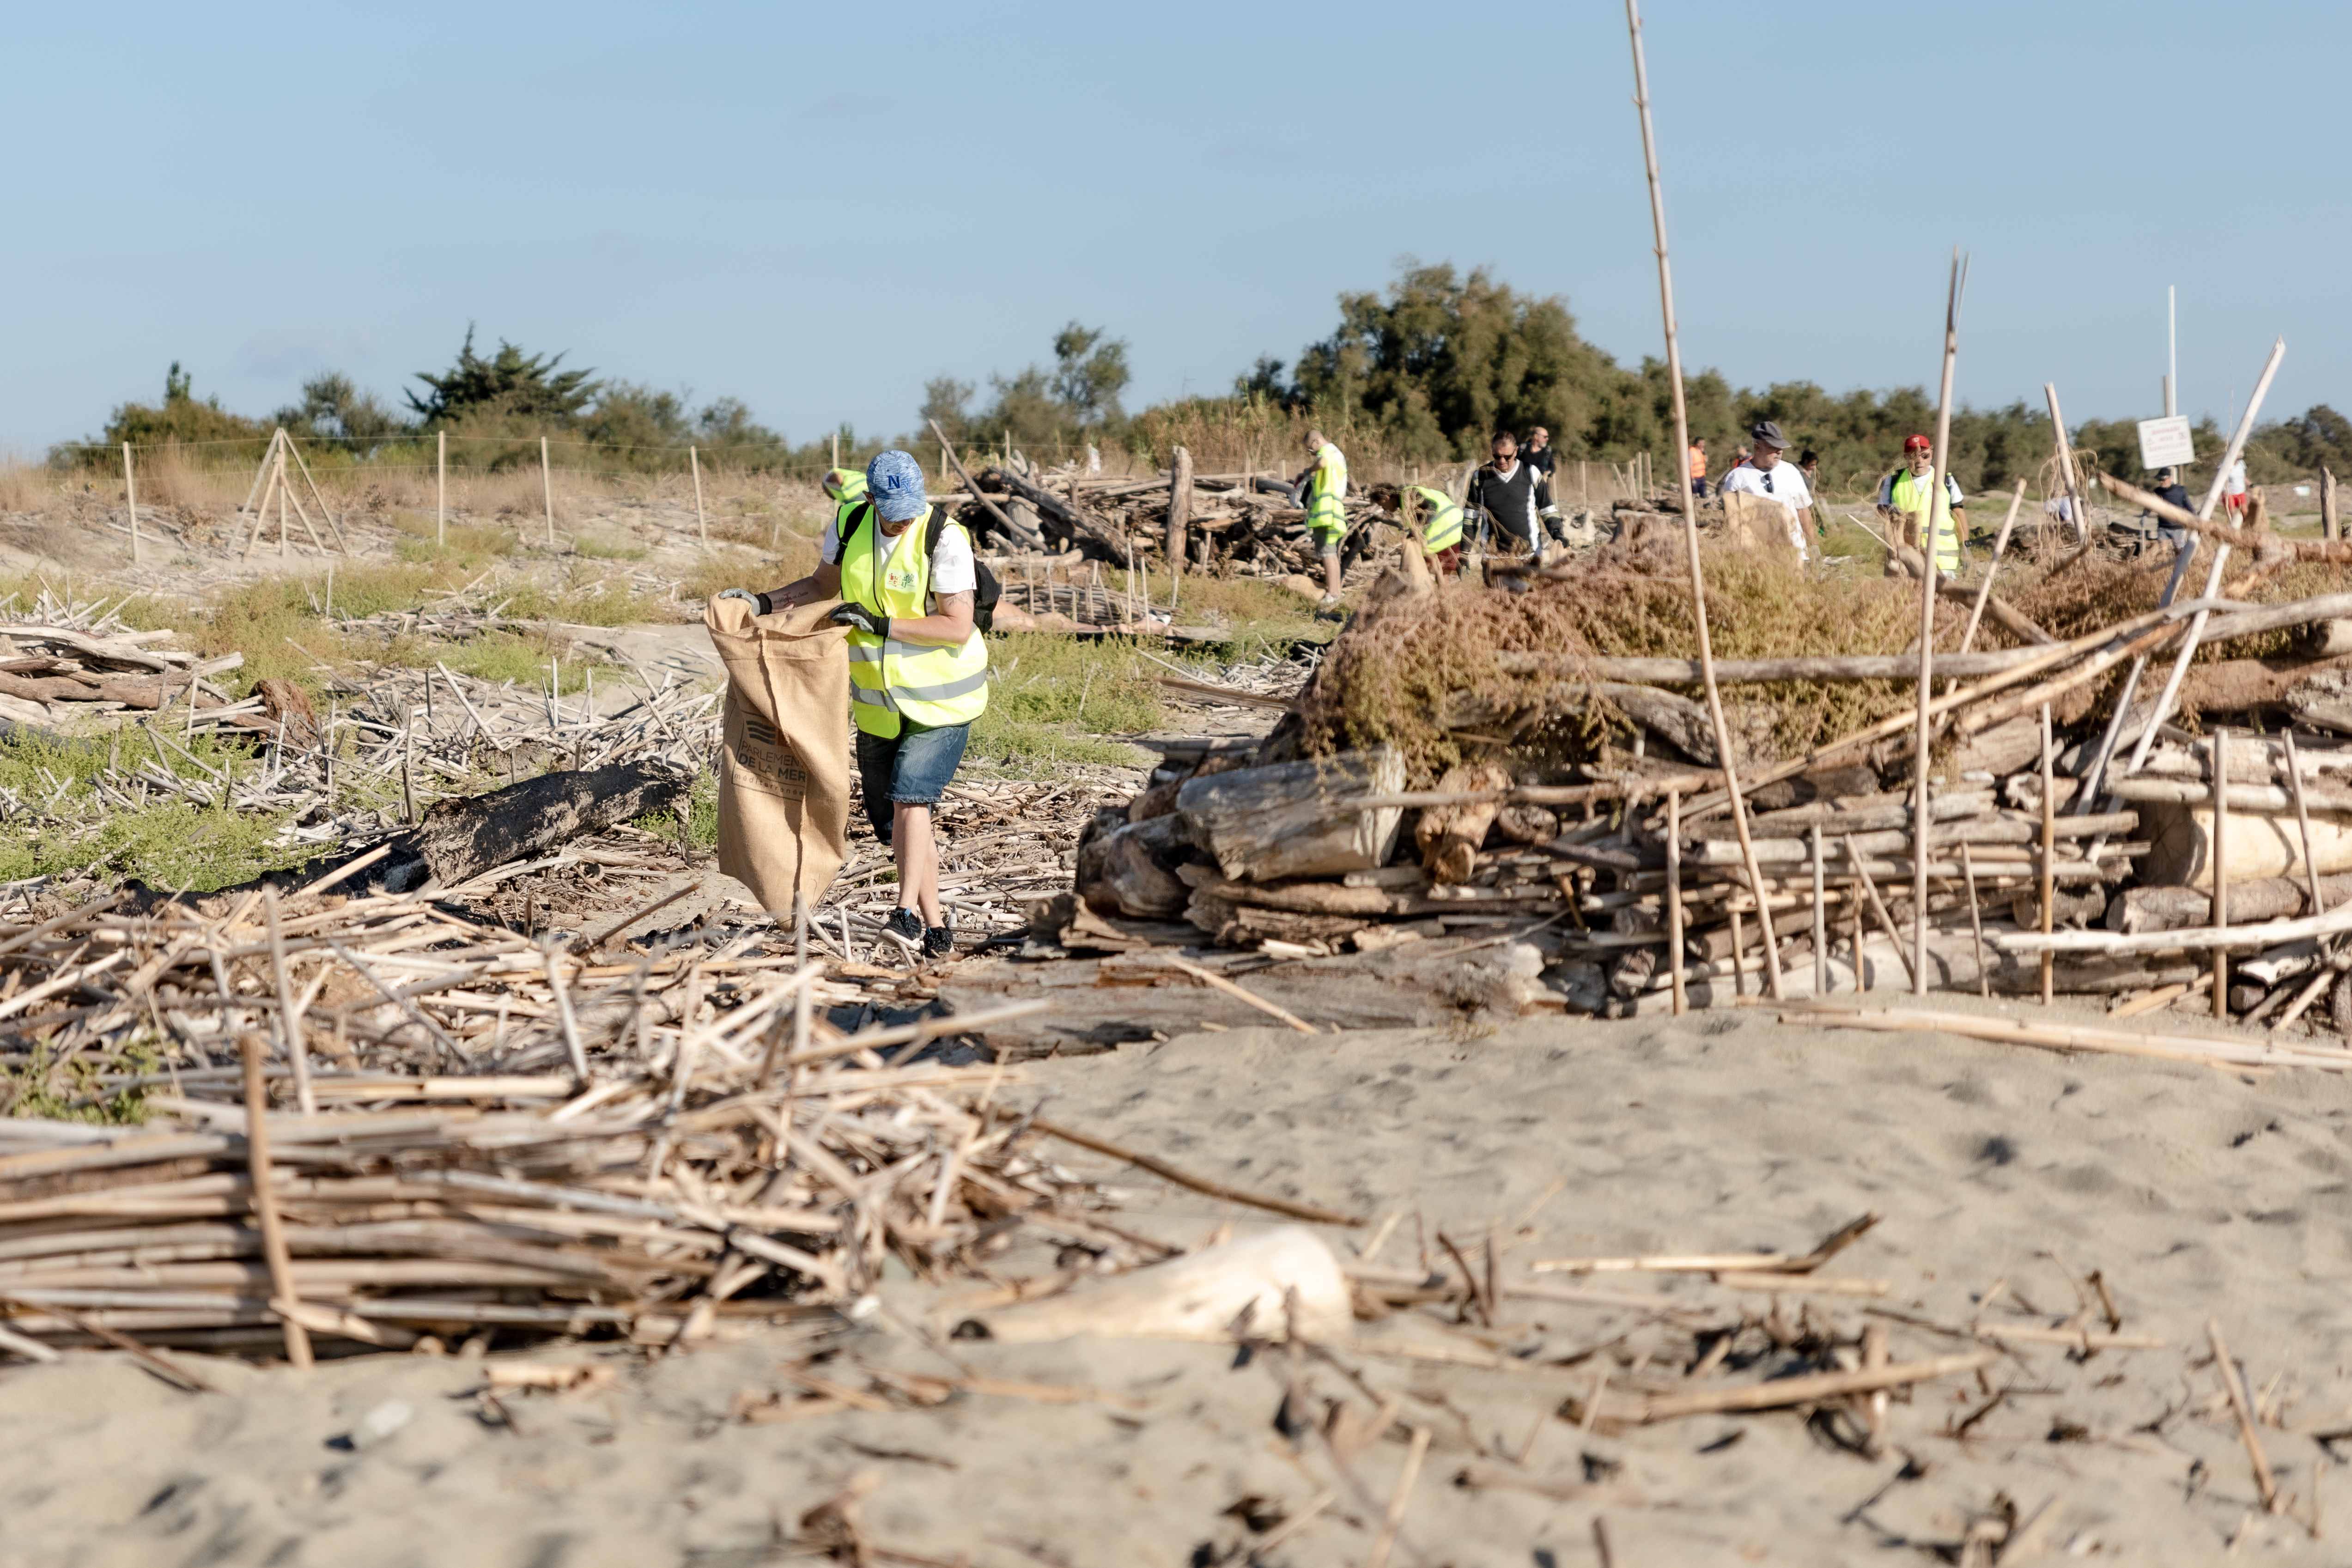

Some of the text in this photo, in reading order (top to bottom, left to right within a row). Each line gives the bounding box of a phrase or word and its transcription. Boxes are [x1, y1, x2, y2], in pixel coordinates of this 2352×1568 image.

[739, 753, 806, 783] DE LA MER
[741, 740, 804, 769] PARLEMEN
[734, 773, 804, 796] méditerranée
